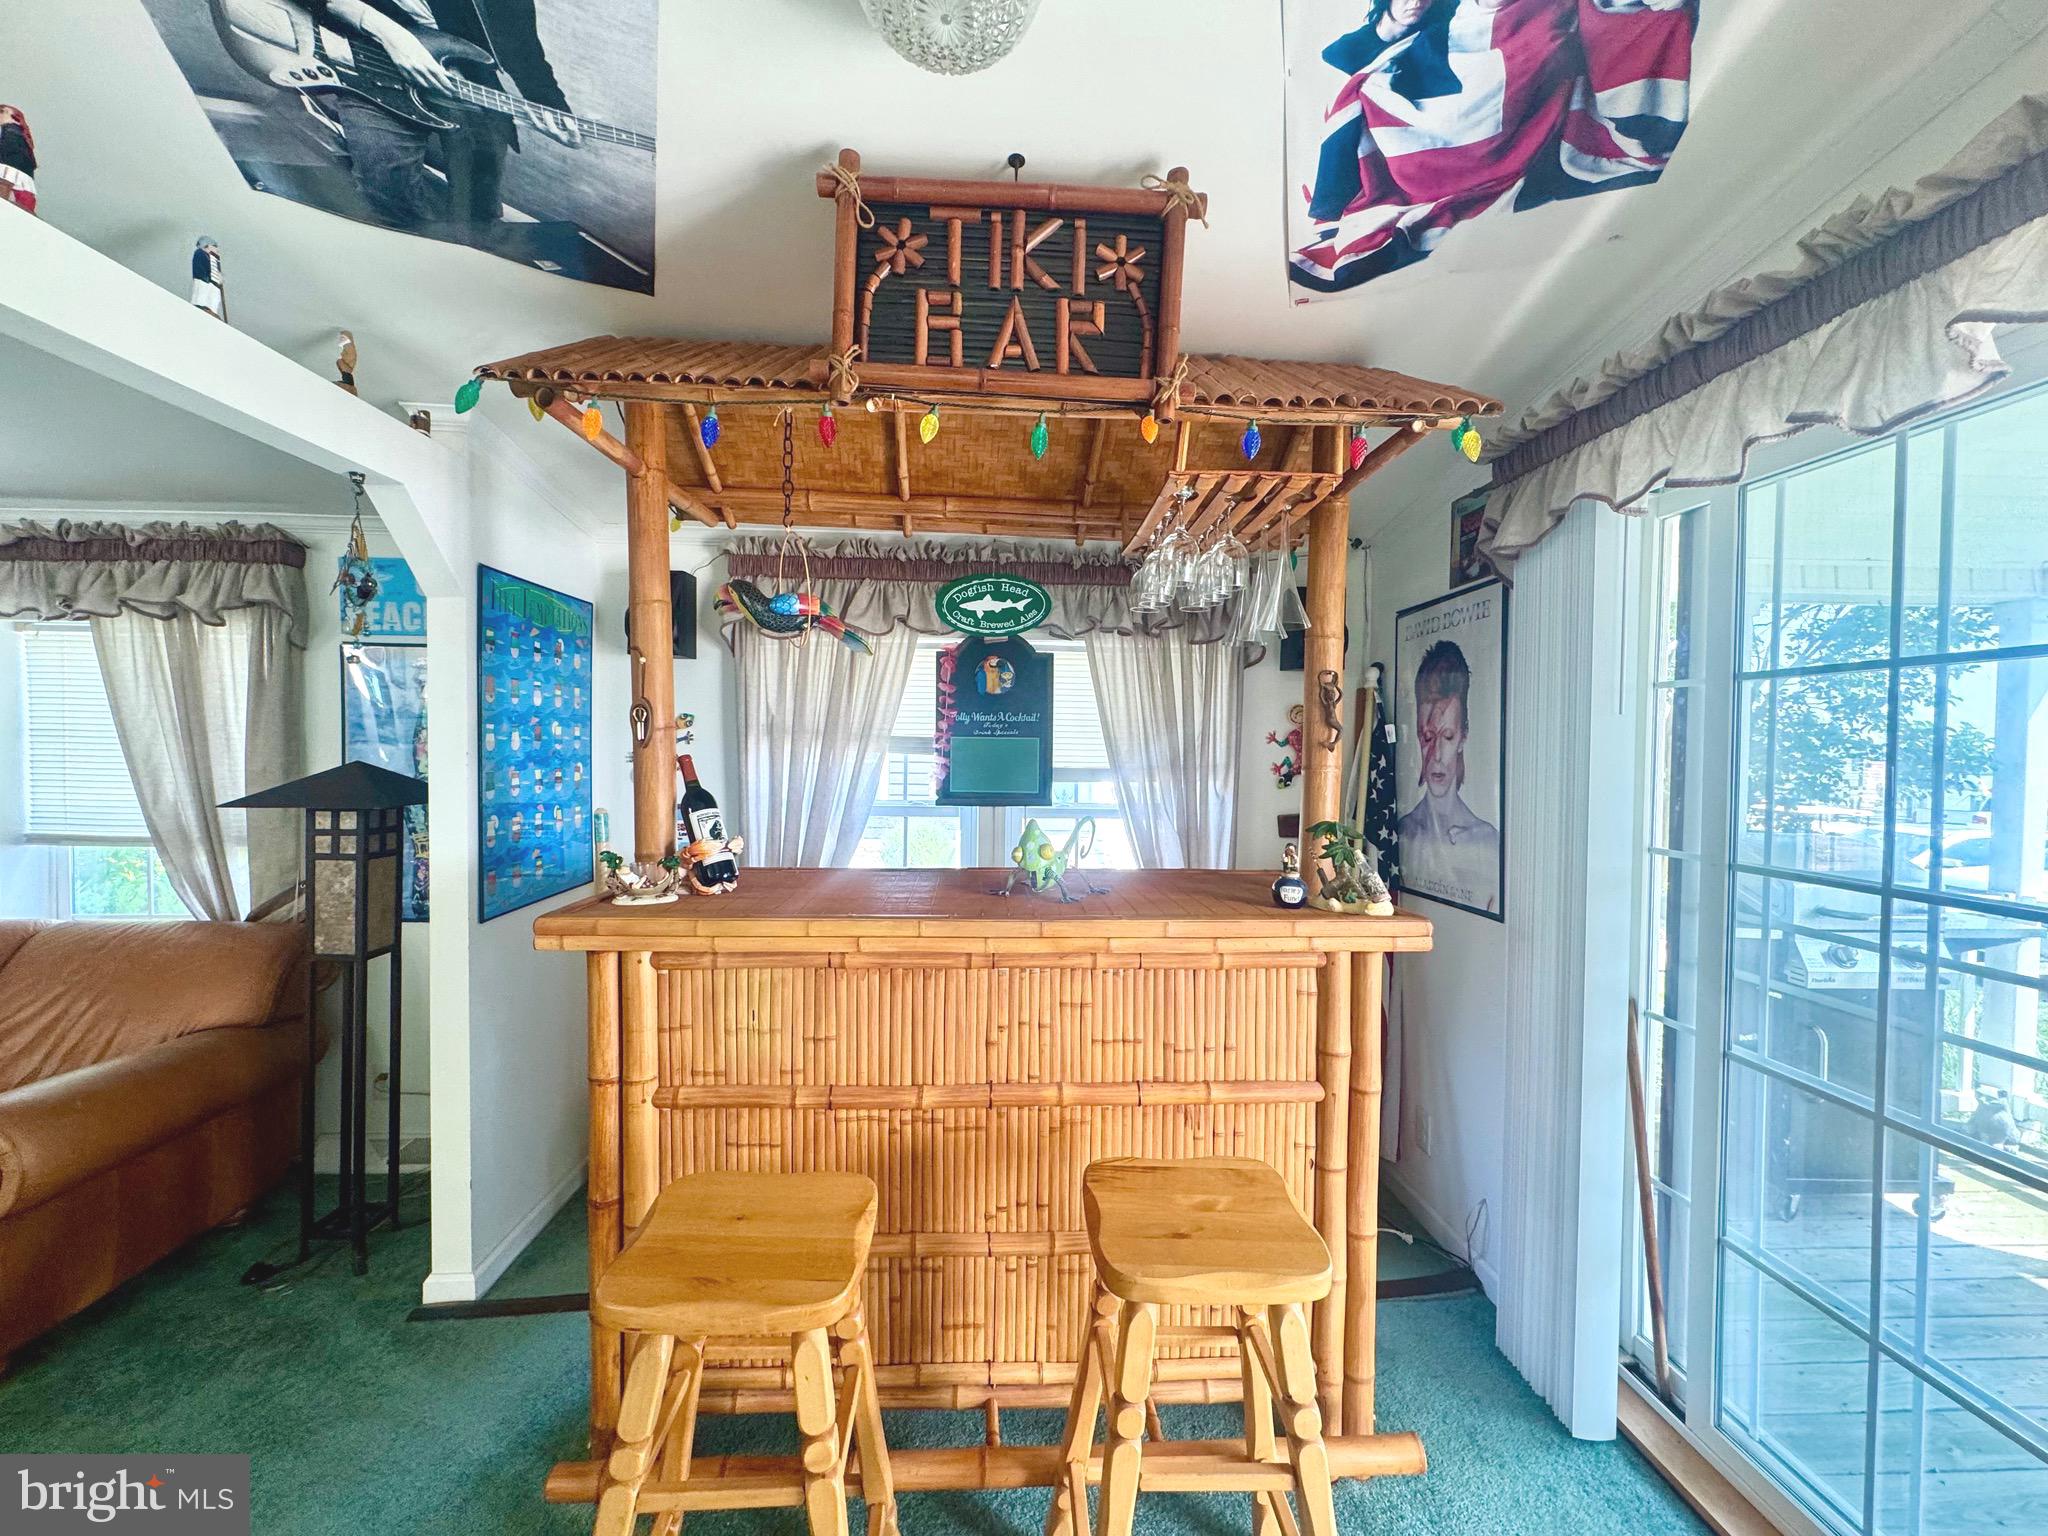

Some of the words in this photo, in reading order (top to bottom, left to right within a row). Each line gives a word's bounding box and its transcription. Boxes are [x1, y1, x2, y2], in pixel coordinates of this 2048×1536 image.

[929, 206, 1088, 296] TIKI
[914, 288, 1106, 375] BAR
[952, 583, 995, 603] Dogfish
[1001, 583, 1030, 597] Head
[952, 610, 975, 626] Craft
[979, 619, 1015, 629] Brewed
[1020, 609, 1038, 624] Ales
[1442, 600, 1491, 630] BOWIE
[971, 711, 997, 722] Wants
[997, 711, 1006, 722] A
[1005, 711, 1040, 722] Cocktail!
